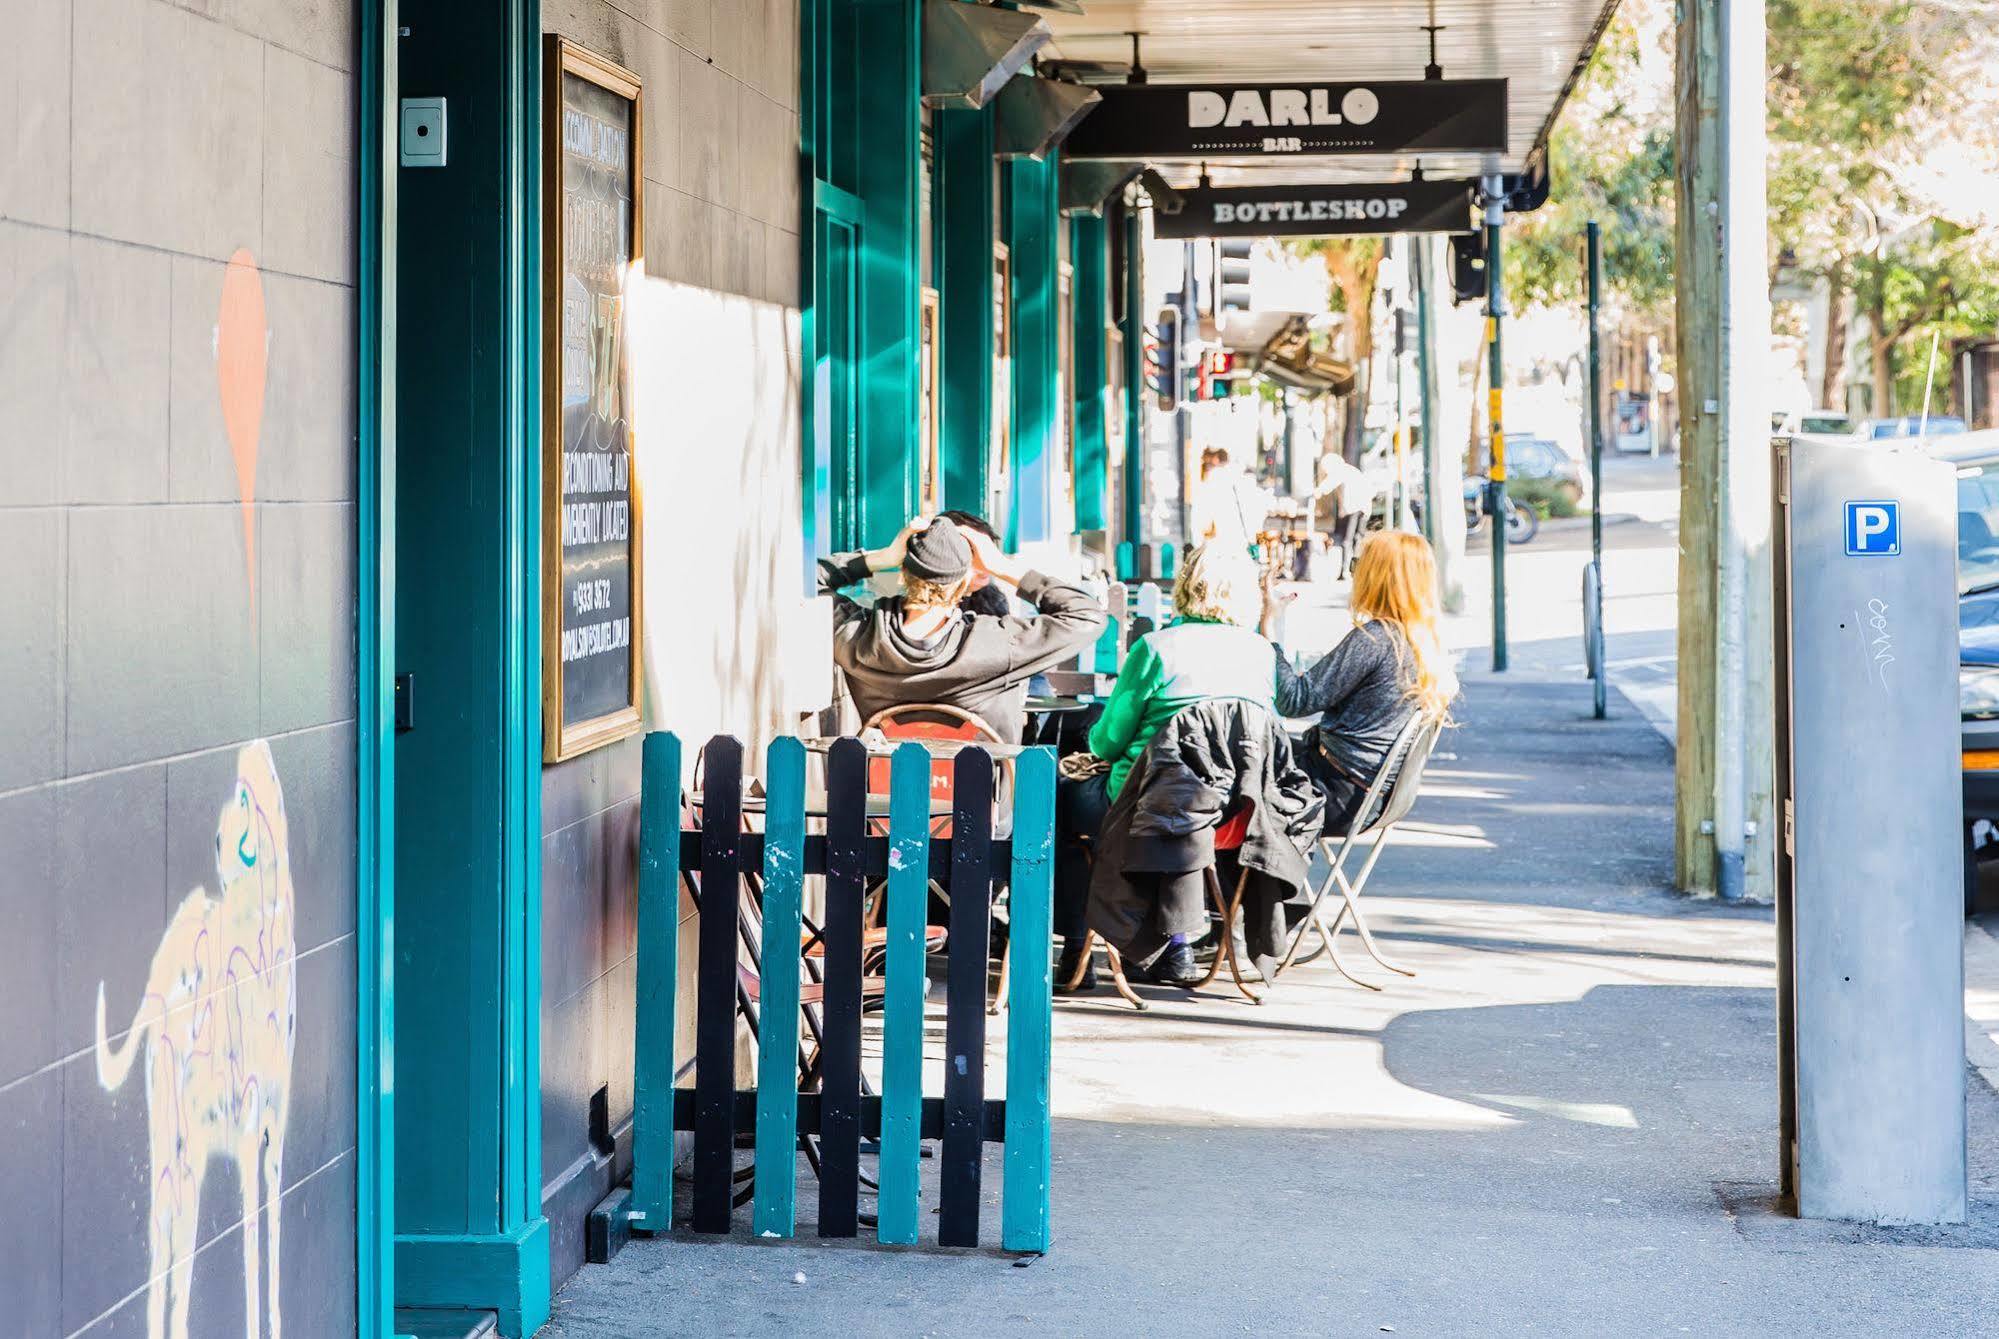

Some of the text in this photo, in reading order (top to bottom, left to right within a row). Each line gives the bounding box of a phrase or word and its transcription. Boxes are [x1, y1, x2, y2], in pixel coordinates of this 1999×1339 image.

[1188, 87, 1380, 128] DARLO
[1262, 137, 1302, 152] BAR
[1213, 198, 1408, 224] BOTTLESHOP
[614, 452, 629, 491] AND
[602, 500, 629, 542] LOCATED
[1855, 507, 1890, 550] P
[594, 578, 611, 610] 3672
